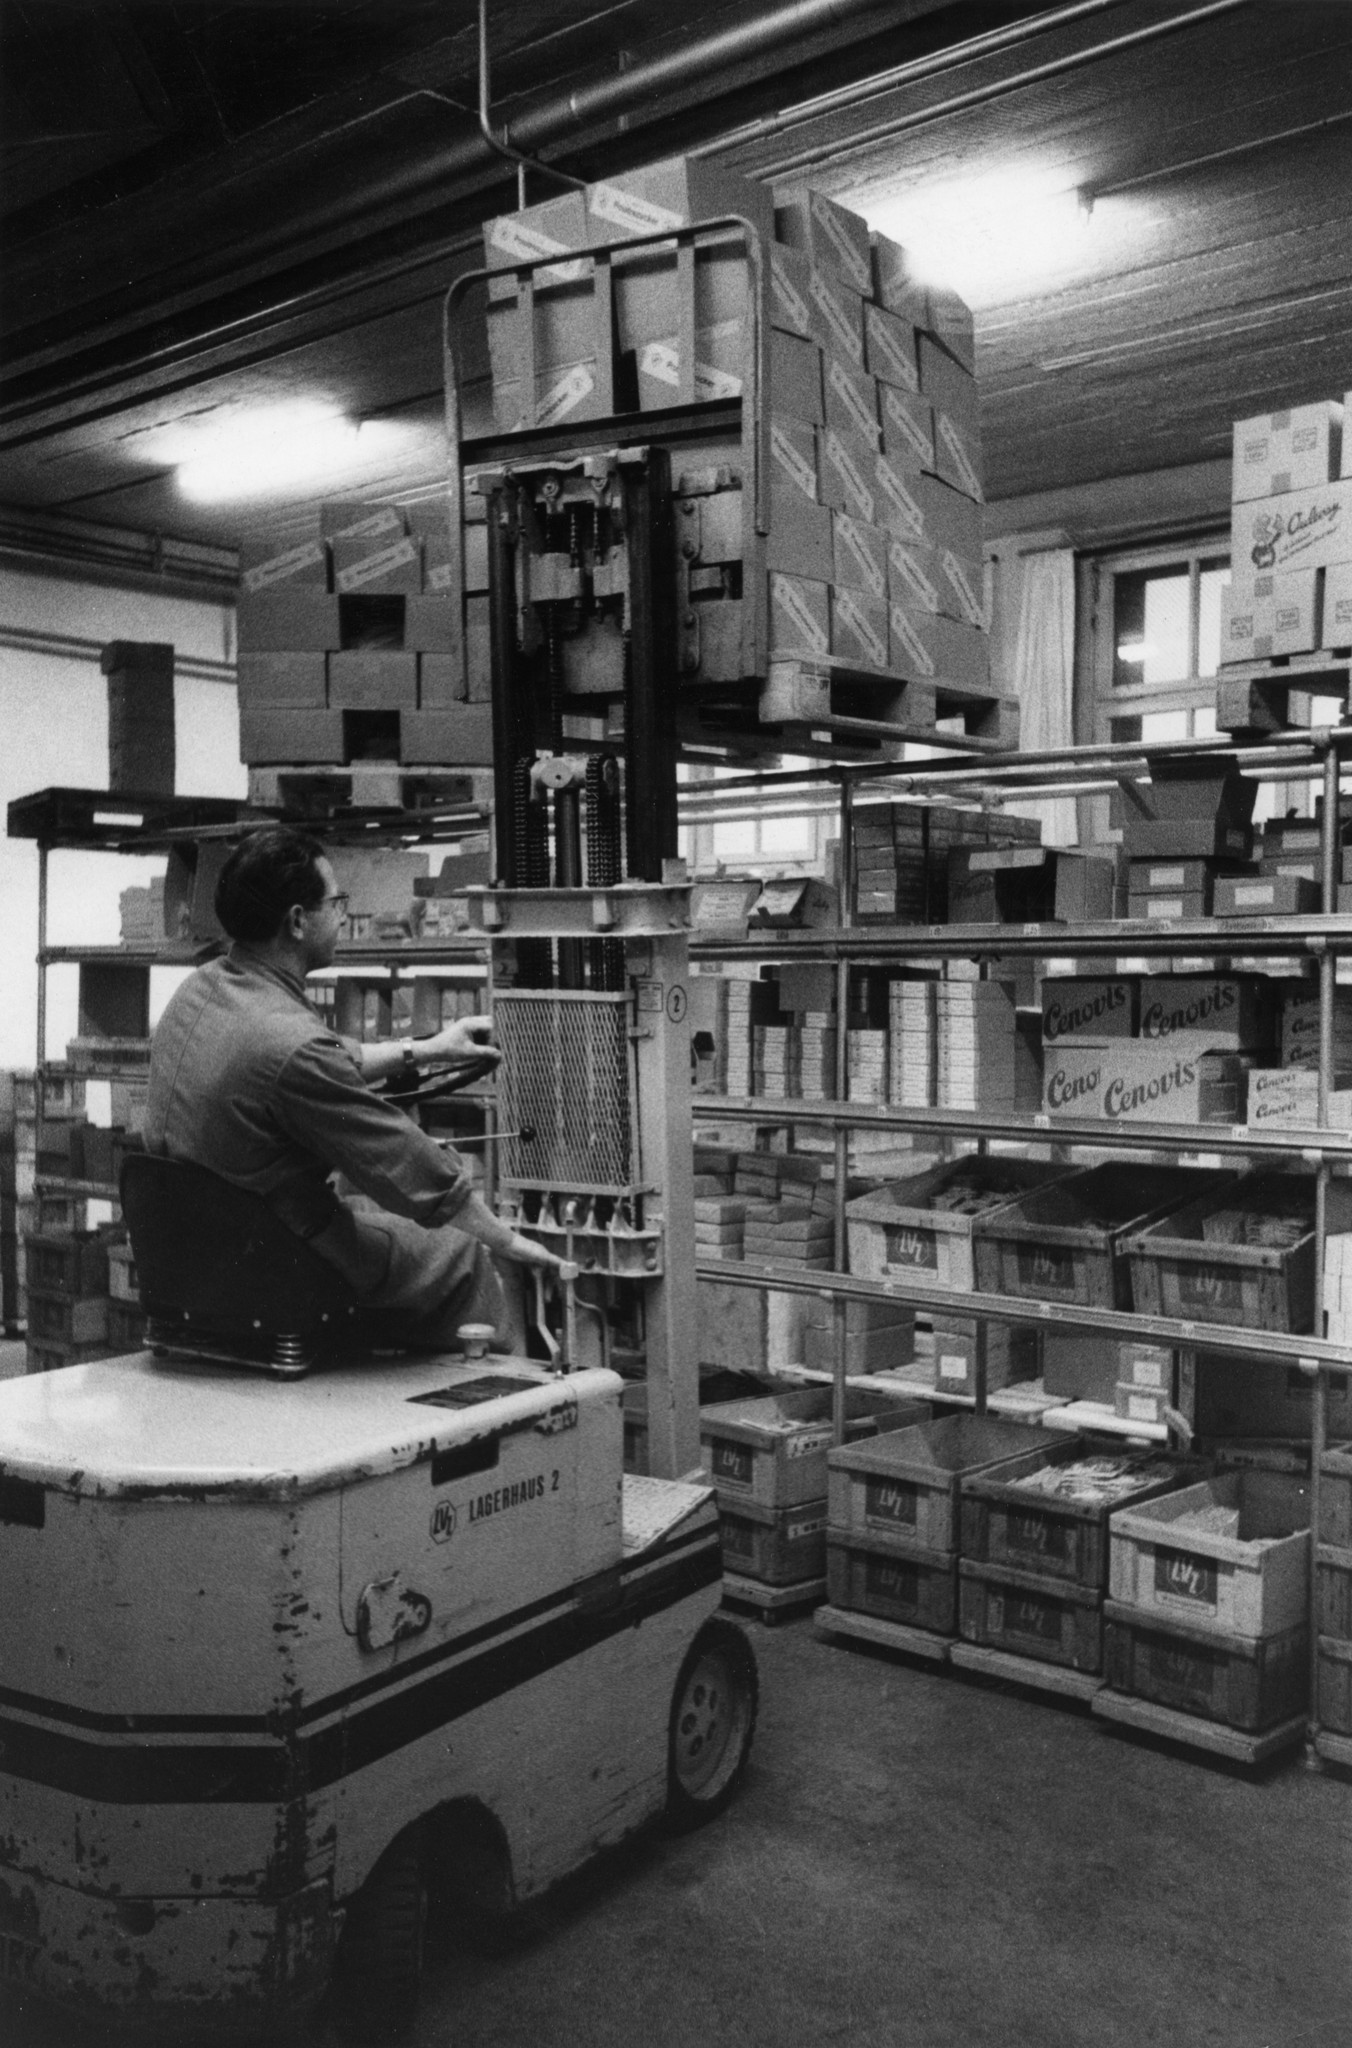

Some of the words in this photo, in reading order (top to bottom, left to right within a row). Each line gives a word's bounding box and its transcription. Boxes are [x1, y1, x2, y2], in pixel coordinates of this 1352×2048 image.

[1044, 985, 1126, 1041] Cenovis
[1143, 984, 1235, 1039] Cenovis
[1048, 1069, 1100, 1108] Ceno
[1104, 1062, 1196, 1117] Cenovis
[469, 1475, 545, 1522] LAGERHAUS
[551, 1469, 560, 1491] 2
